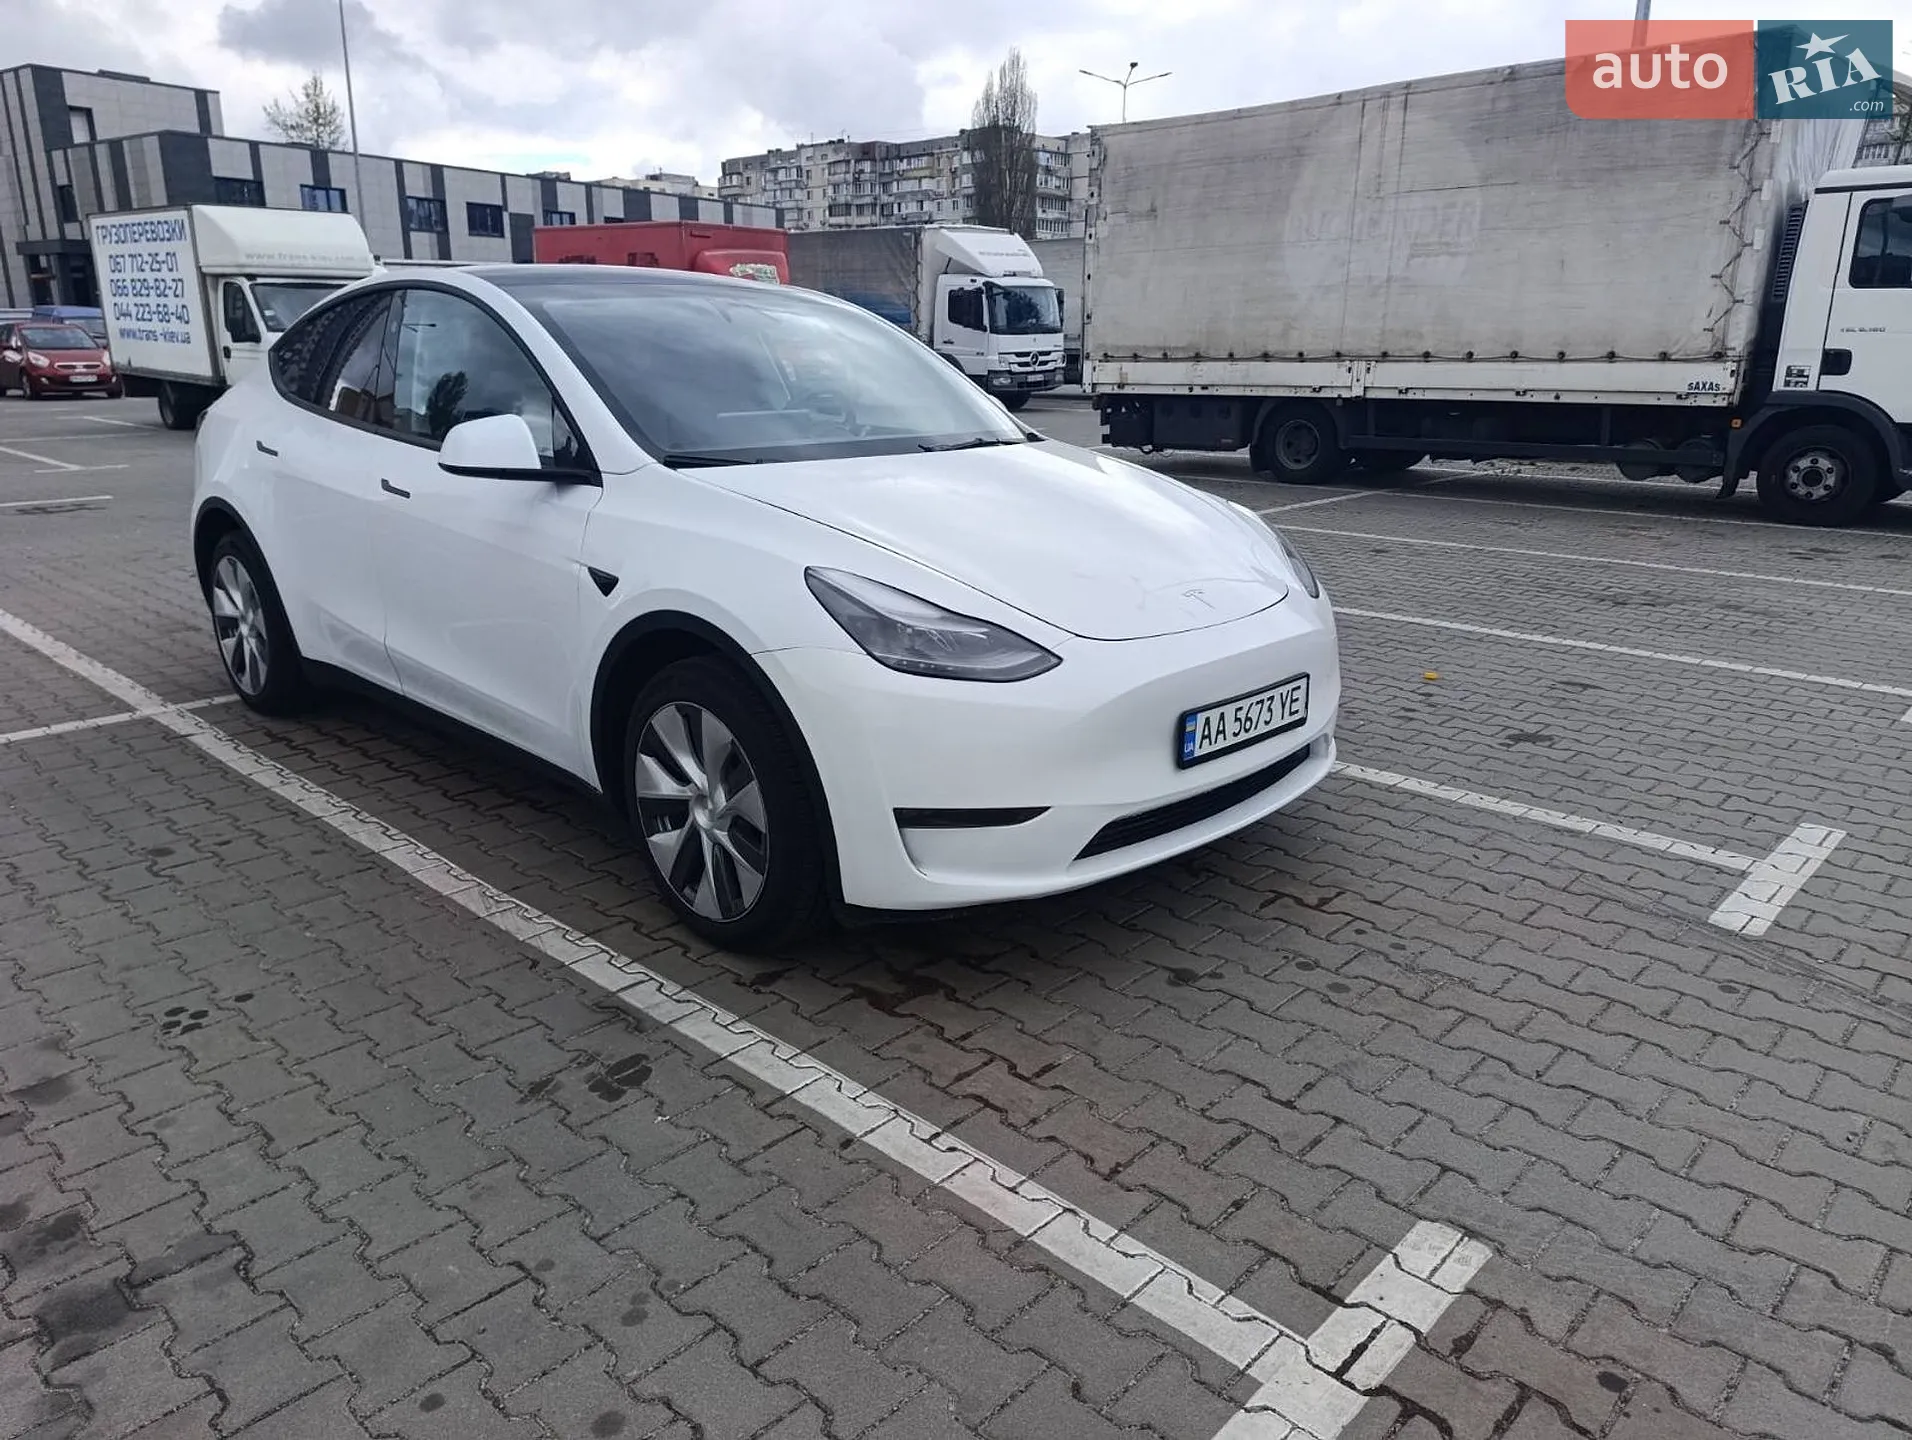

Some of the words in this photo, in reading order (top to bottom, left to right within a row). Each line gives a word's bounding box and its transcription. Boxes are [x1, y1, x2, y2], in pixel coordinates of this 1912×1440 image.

[95, 219, 187, 245] ГРУЗОПЕРЕВОЗКИ
[109, 254, 125, 273] 067
[128, 252, 179, 273] 712-25-01
[110, 279, 129, 298] 066
[130, 278, 185, 298] 829-82-27
[113, 302, 132, 322] 044
[133, 303, 190, 324] 223-68-40
[1199, 712, 1227, 749] AA
[1232, 695, 1275, 737] 5673
[1280, 685, 1301, 720] YE
